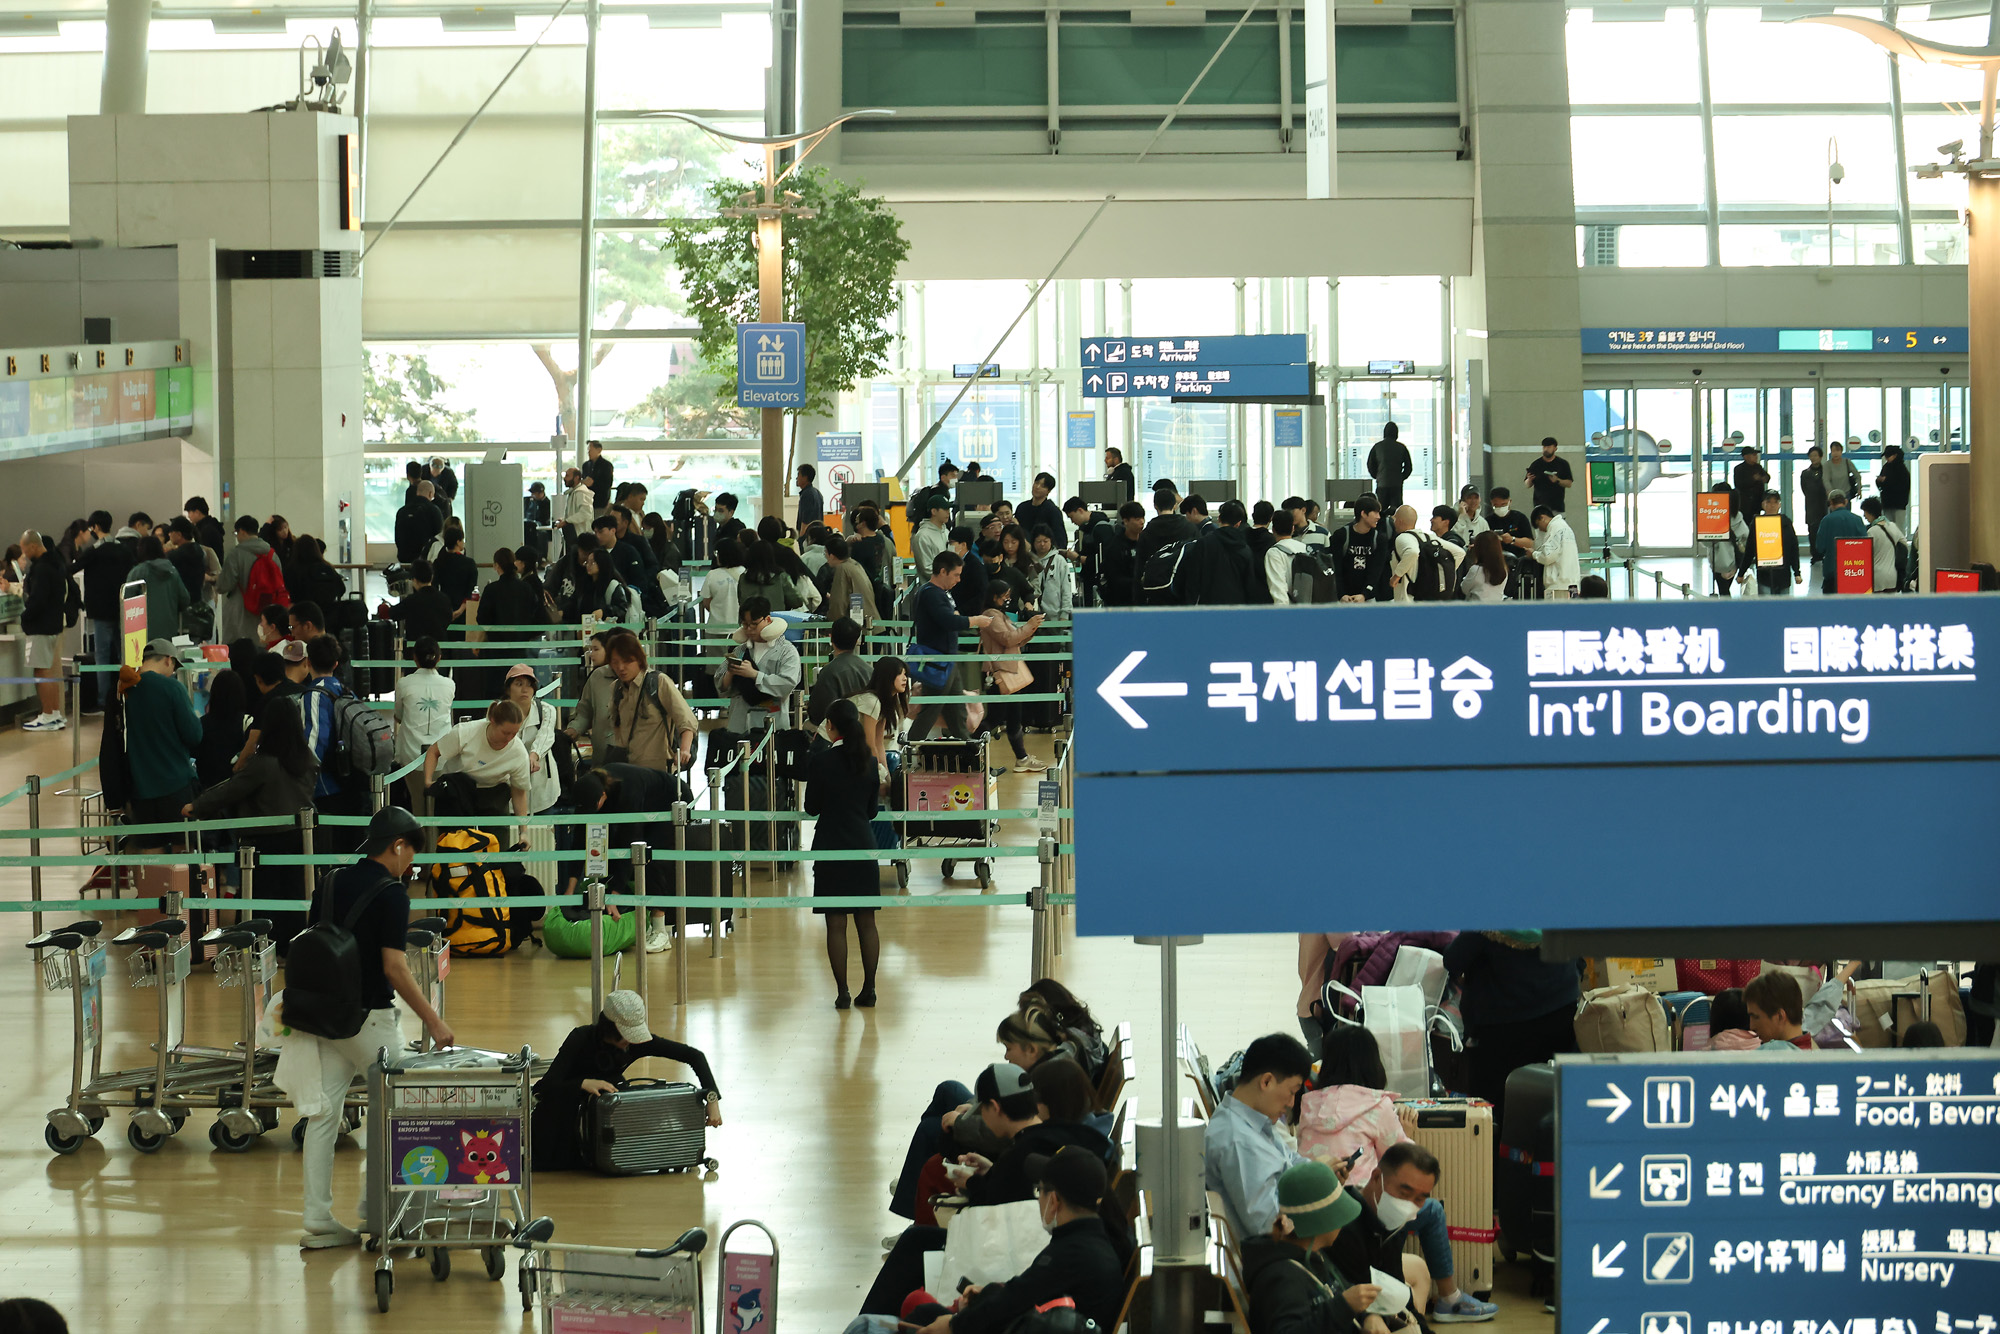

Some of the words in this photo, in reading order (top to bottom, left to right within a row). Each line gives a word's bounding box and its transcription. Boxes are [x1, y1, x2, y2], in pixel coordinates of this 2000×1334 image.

[1608, 331, 1636, 342] 여기는
[1689, 330, 1717, 342] 입니다
[1906, 331, 1917, 348] 5
[1131, 344, 1154, 358] 도착
[1667, 343, 1699, 351] Departures
[1700, 342, 1713, 350] Hall
[1159, 352, 1197, 362] Arrivals
[1133, 375, 1170, 390] 주차장
[1175, 382, 1212, 395] Parking
[743, 389, 800, 402] Elevators
[484, 513, 495, 523] kg
[1699, 507, 1711, 515] Bag
[1712, 507, 1728, 515] drop
[1759, 531, 1779, 540] Priority
[1844, 568, 1864, 577] 하노이
[1208, 655, 1494, 723] 국제선탑승
[1529, 692, 1622, 737] Int'l
[1642, 689, 1869, 744] Boarding
[713, 749, 795, 766] JODAN
[1710, 1083, 1770, 1129] 식사,
[1783, 1082, 1841, 1118] 음료
[1856, 1101, 1920, 1129] Food,
[1780, 1182, 1886, 1209] Currency
[1709, 1238, 1846, 1274] 유아휴게실
[1861, 1257, 1955, 1289] Nursery
